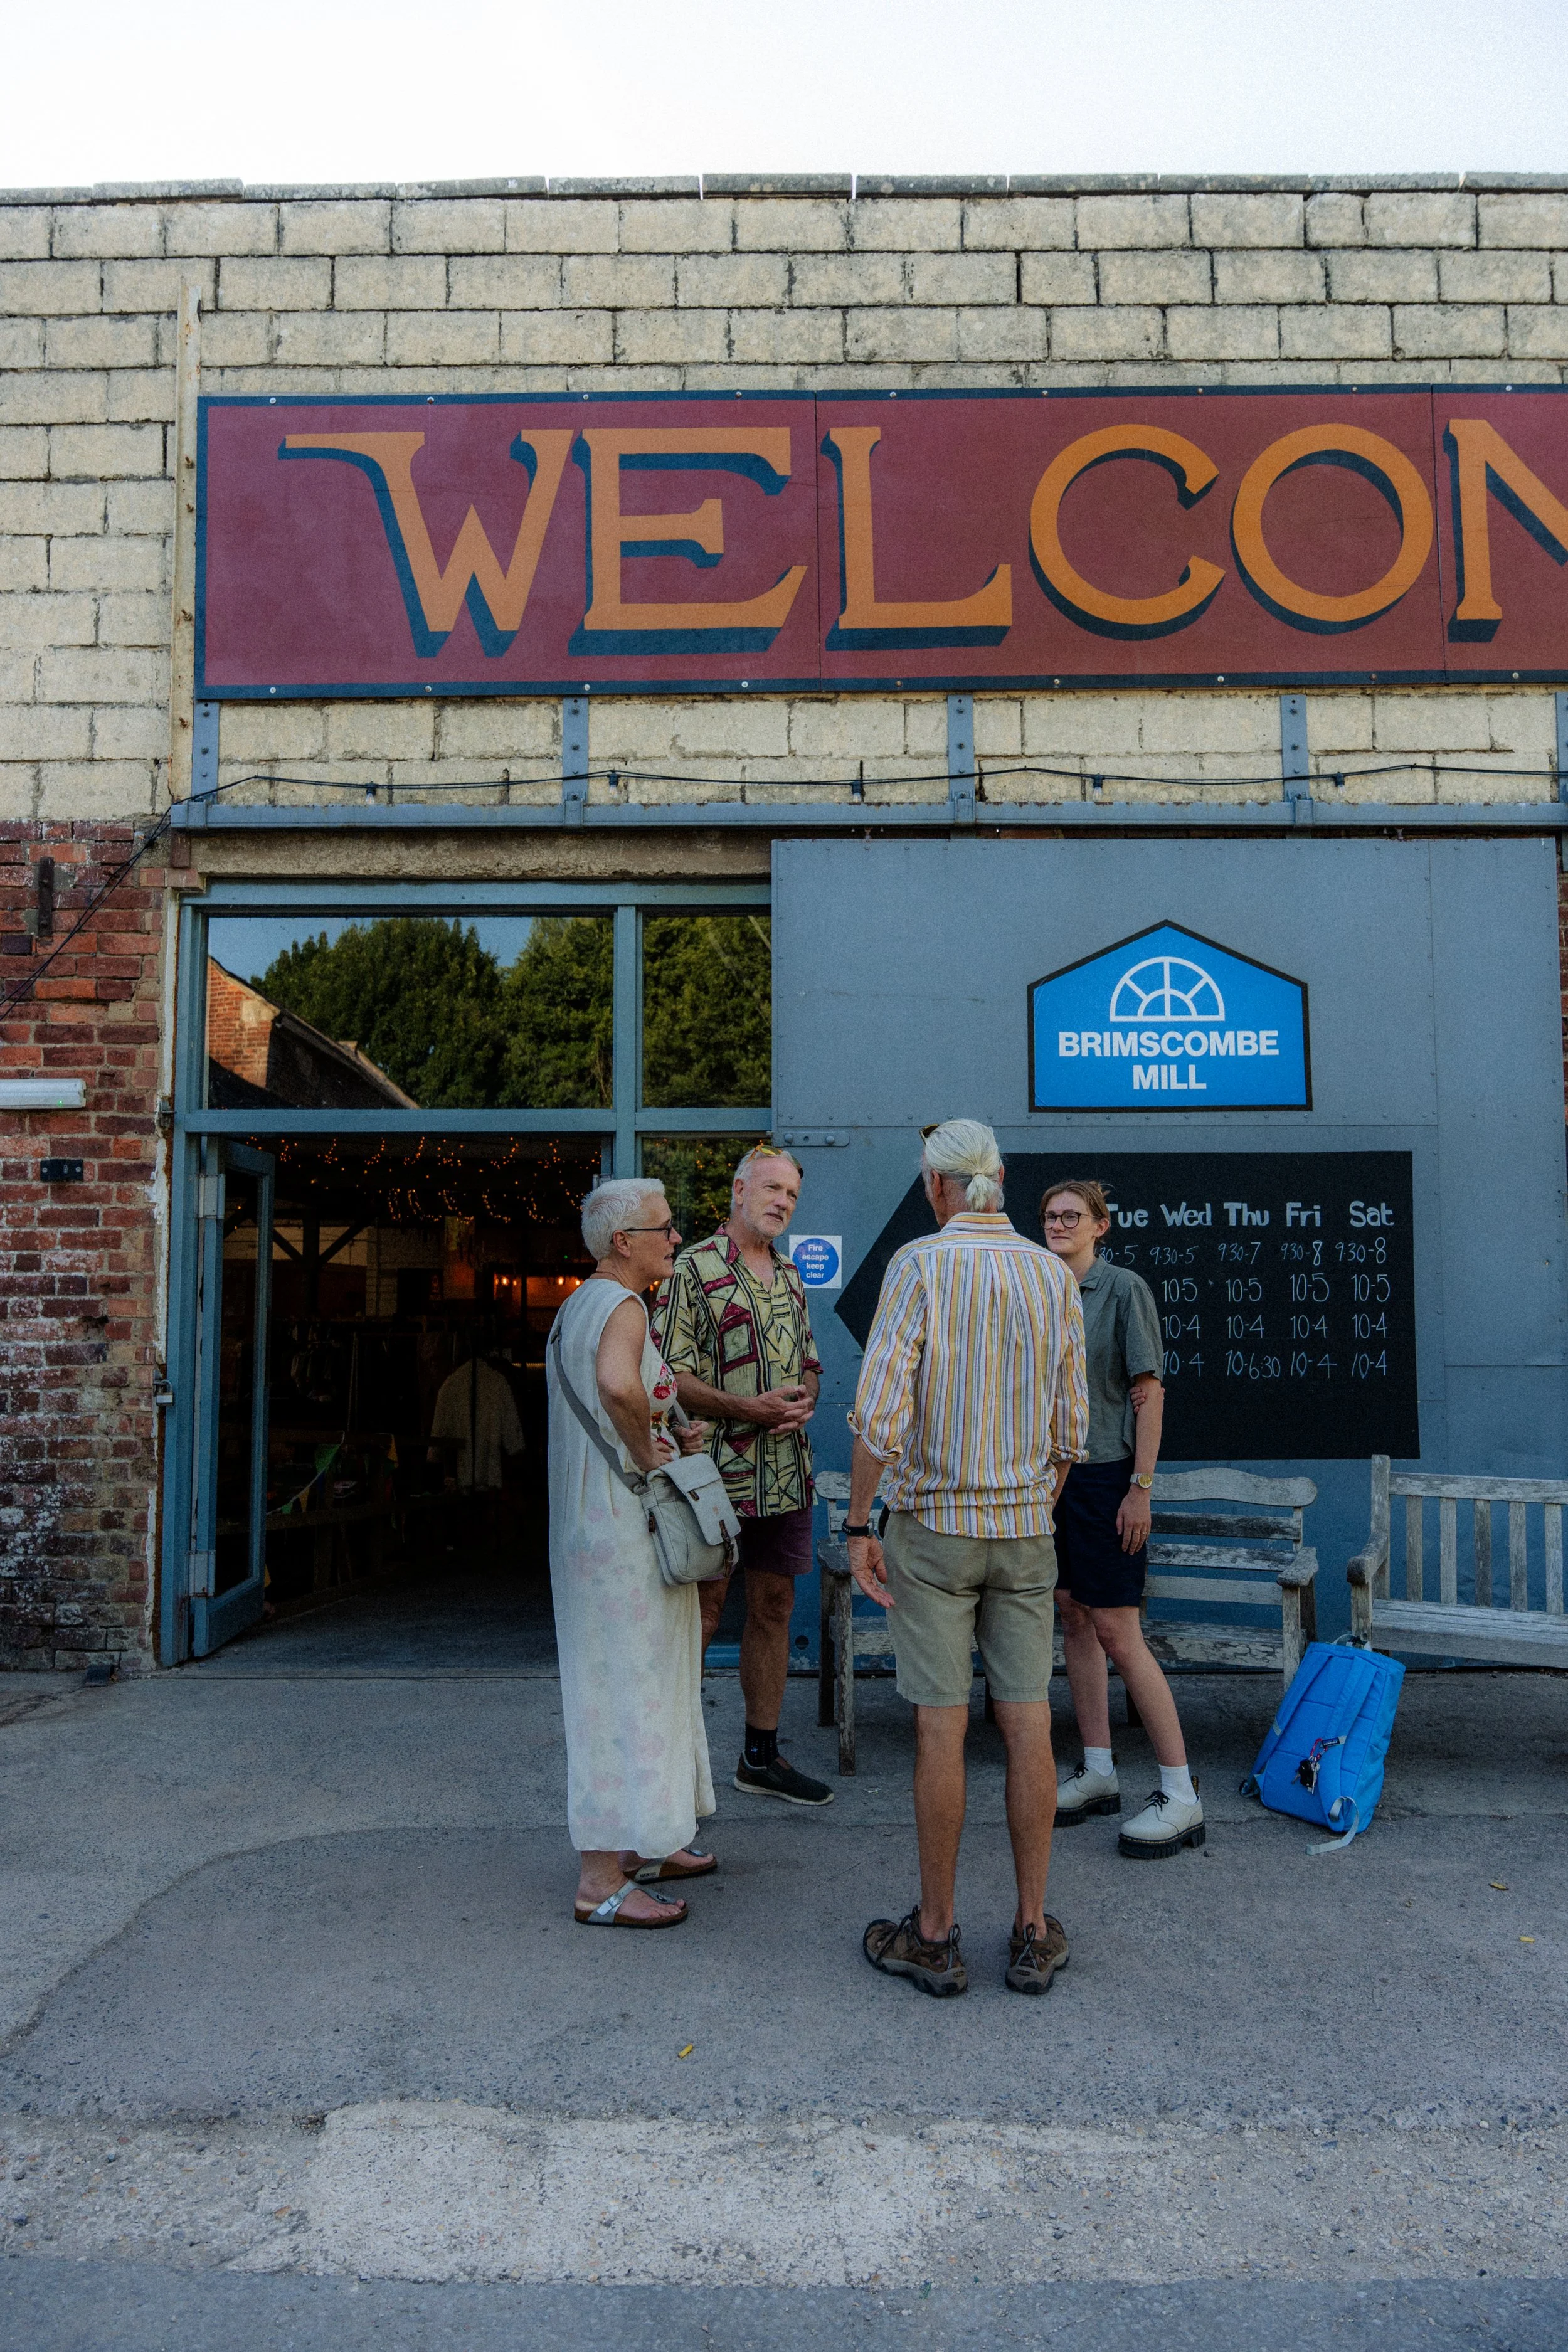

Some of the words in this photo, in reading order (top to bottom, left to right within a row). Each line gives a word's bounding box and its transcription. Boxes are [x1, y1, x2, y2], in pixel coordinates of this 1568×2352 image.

[1059, 1030, 1279, 1057] BRIMSCOMBE
[1133, 1064, 1207, 1089] MILL
[1160, 1201, 1212, 1227] Wed
[1223, 1202, 1269, 1226] Thu
[1286, 1202, 1321, 1227] Fri
[1349, 1200, 1394, 1227] Sat
[806, 1263, 825, 1271] keep
[1161, 1278, 1198, 1303] 10-5
[1226, 1278, 1262, 1302] 10-5
[1290, 1273, 1330, 1302] 10-5
[1351, 1274, 1391, 1303] 10-5
[1162, 1314, 1201, 1339] 10-4
[1226, 1315, 1264, 1338] 10-4
[1290, 1315, 1328, 1339] 10-4
[1352, 1312, 1387, 1339] 10-4
[1163, 1350, 1204, 1377] 10-4
[1291, 1351, 1337, 1379] 10-4
[1352, 1350, 1387, 1379] 10-4
